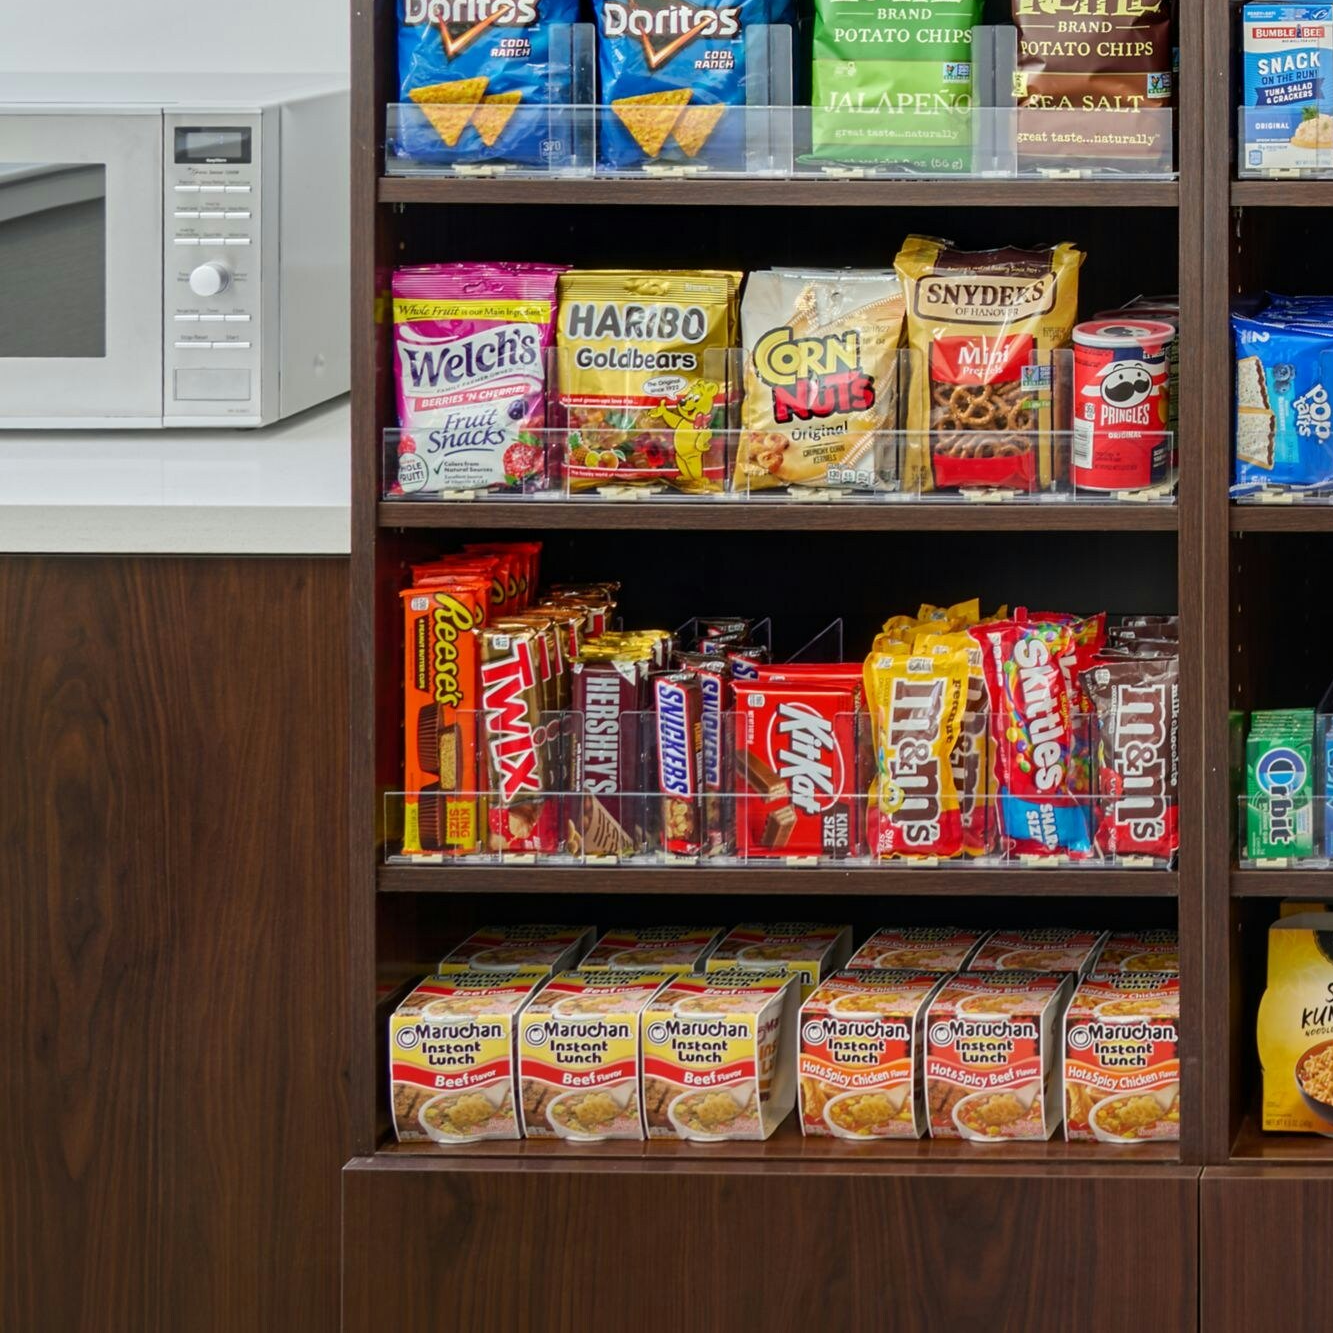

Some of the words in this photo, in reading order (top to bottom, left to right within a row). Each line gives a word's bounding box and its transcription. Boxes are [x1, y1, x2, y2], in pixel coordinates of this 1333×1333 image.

[877, 9, 932, 20] BRAND
[834, 28, 911, 43] POTATO
[916, 28, 972, 43] CHIPS
[1256, 28, 1295, 38] BUMBLE
[1304, 28, 1322, 37] BEE
[1258, 52, 1320, 74] SNACK
[1297, 70, 1318, 81] RUN!
[1264, 88, 1286, 97] TUNA
[1289, 84, 1313, 94] SALAD
[1274, 91, 1313, 103] CRACKERS
[824, 89, 972, 114] JALAPEÑO
[1028, 95, 1074, 112] SEA
[1082, 96, 1143, 113] SALT
[569, 305, 705, 339] HARIBO
[404, 328, 537, 386] Welch's
[576, 348, 696, 369] Goldbears
[755, 327, 859, 386] CORN
[658, 378, 681, 387] Original
[421, 395, 462, 407] BERRIES
[481, 386, 525, 399] CHERRIES
[773, 371, 874, 423] NUTS
[444, 410, 496, 434] Fruit
[1101, 403, 1149, 425] PRINGLES
[427, 427, 505, 453] Snacks
[792, 421, 848, 441] Original
[434, 593, 474, 708] Reese's
[1015, 638, 1062, 790] Skittles
[584, 677, 621, 795] HERSHEY'S
[657, 680, 690, 797] SNICKERS
[824, 816, 835, 846] SIZE
[837, 813, 848, 846] KING
[415, 1023, 503, 1038] Maruchan
[823, 1021, 908, 1037] Maruchan
[422, 1042, 481, 1054] Instant
[429, 1053, 475, 1065] Lunch
[435, 1073, 468, 1088] Beef
[471, 1070, 496, 1083] Flavor
